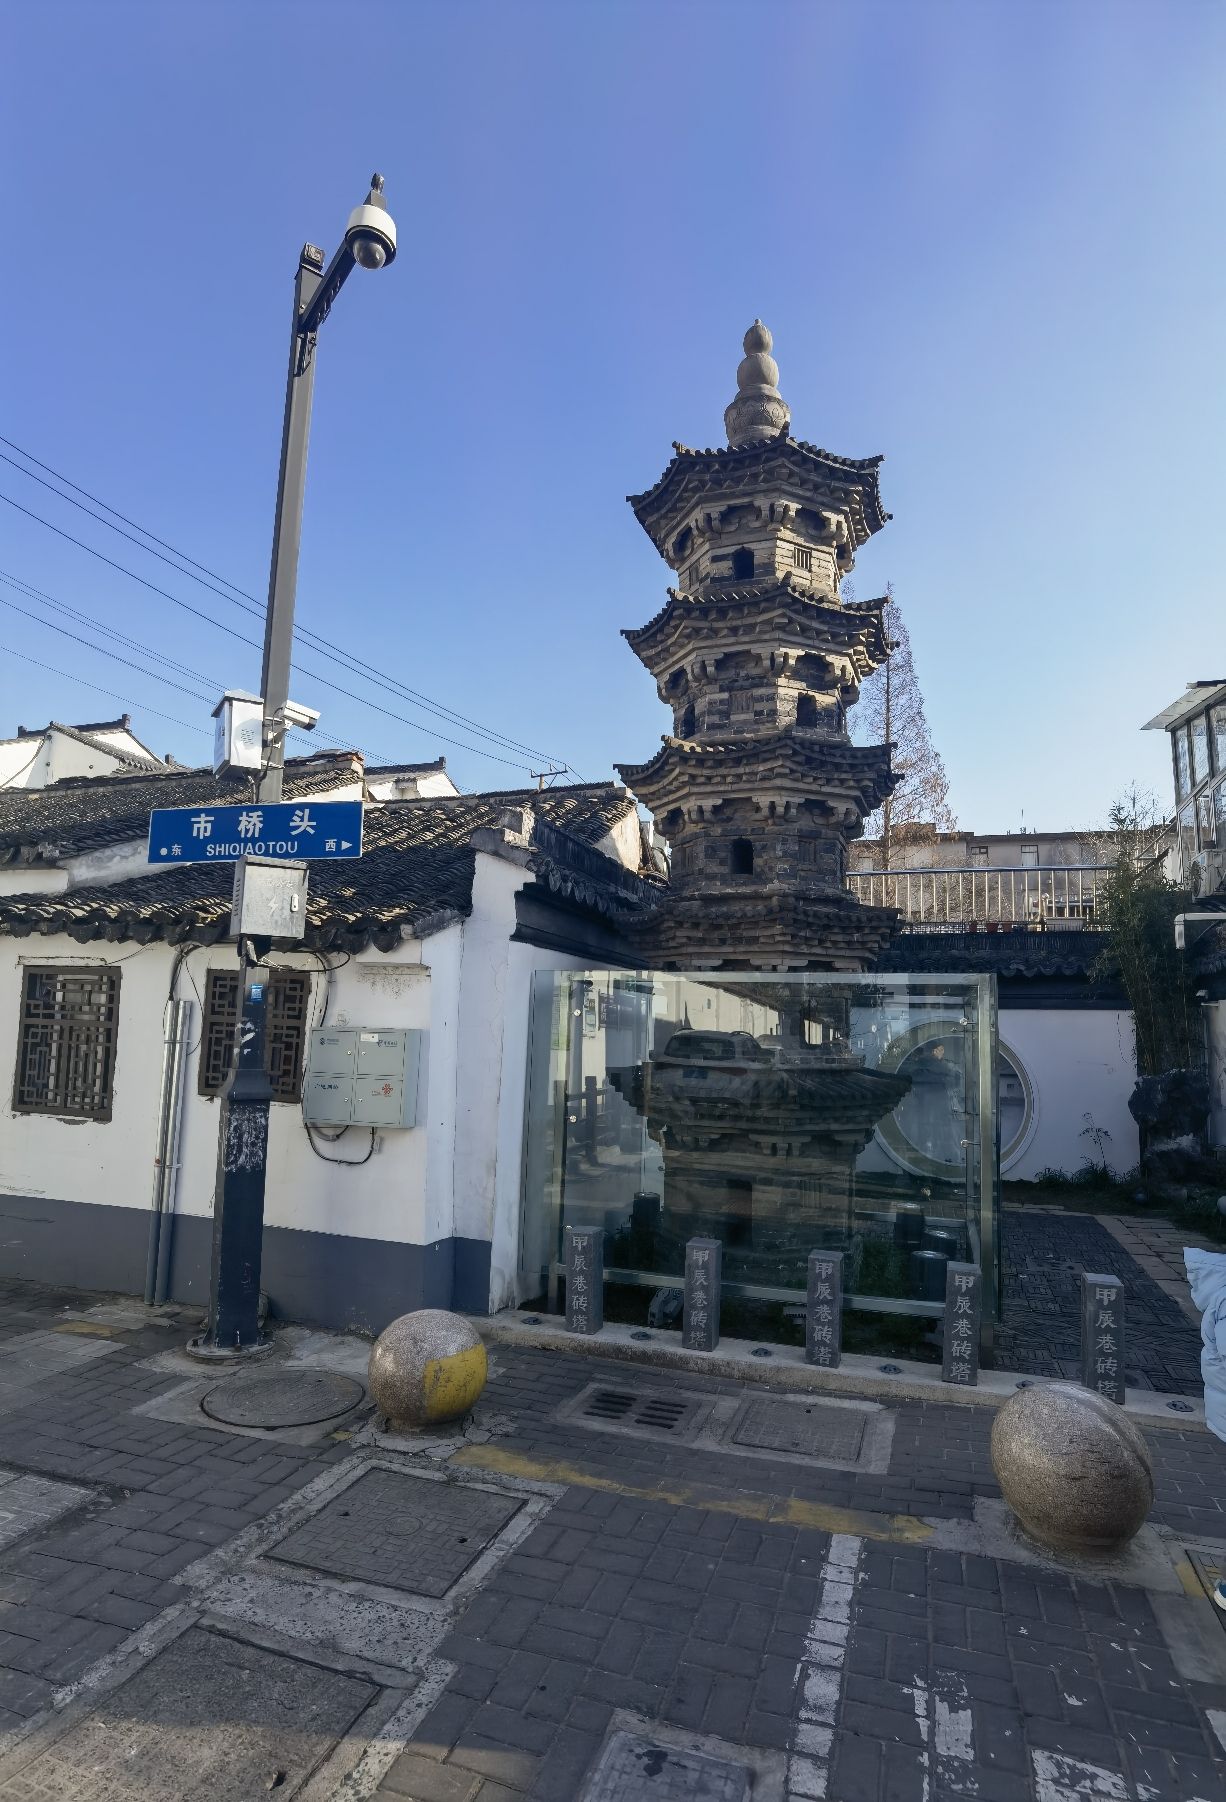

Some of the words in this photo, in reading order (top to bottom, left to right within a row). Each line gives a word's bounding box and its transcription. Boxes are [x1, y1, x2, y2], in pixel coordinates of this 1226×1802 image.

[171, 843, 182, 856] 东
[191, 809, 316, 839] 市桥头
[206, 841, 298, 857] SHIQIAOTOU
[325, 839, 337, 852] 西
[571, 1235, 588, 1331] 甲辰巷砖塔
[690, 1249, 709, 1347] 甲辰巷砖塔
[813, 1261, 834, 1364] 甲辰巷砖塔
[951, 1273, 975, 1381] 甲辰巷砖塔
